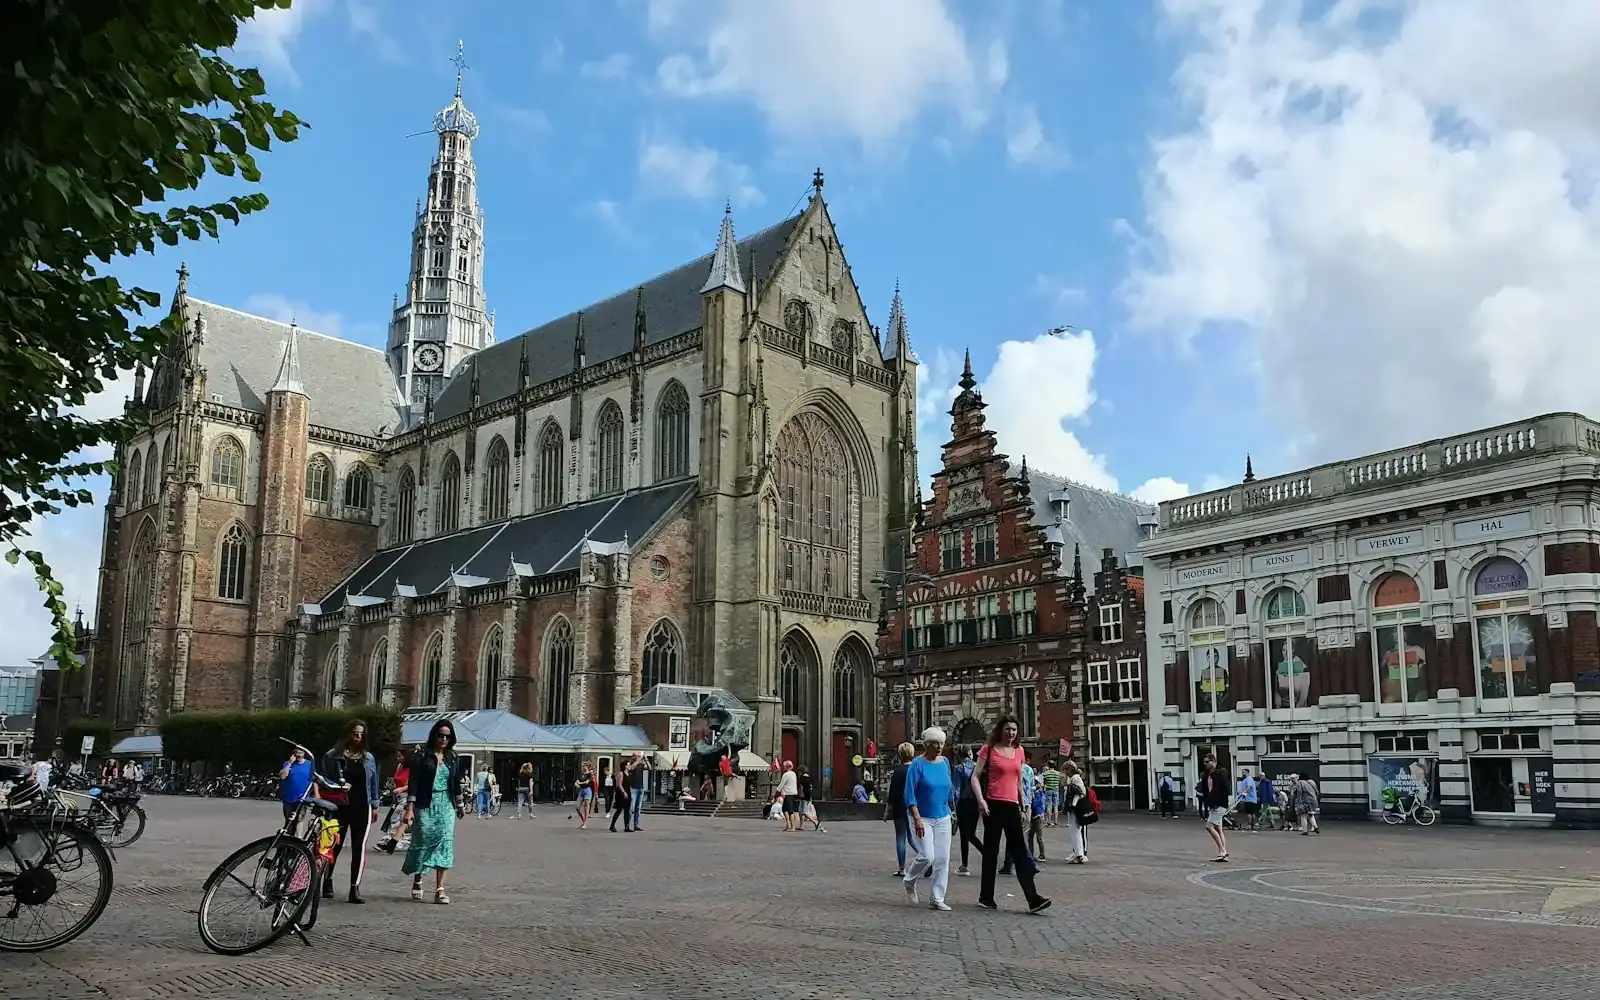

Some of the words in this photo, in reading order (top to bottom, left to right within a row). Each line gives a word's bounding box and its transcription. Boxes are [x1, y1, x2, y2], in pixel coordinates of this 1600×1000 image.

[1183, 566, 1224, 580] MODERNE
[1265, 554, 1295, 566] KUNST
[1369, 535, 1411, 549] VERWEY
[1480, 520, 1504, 532] HAL
